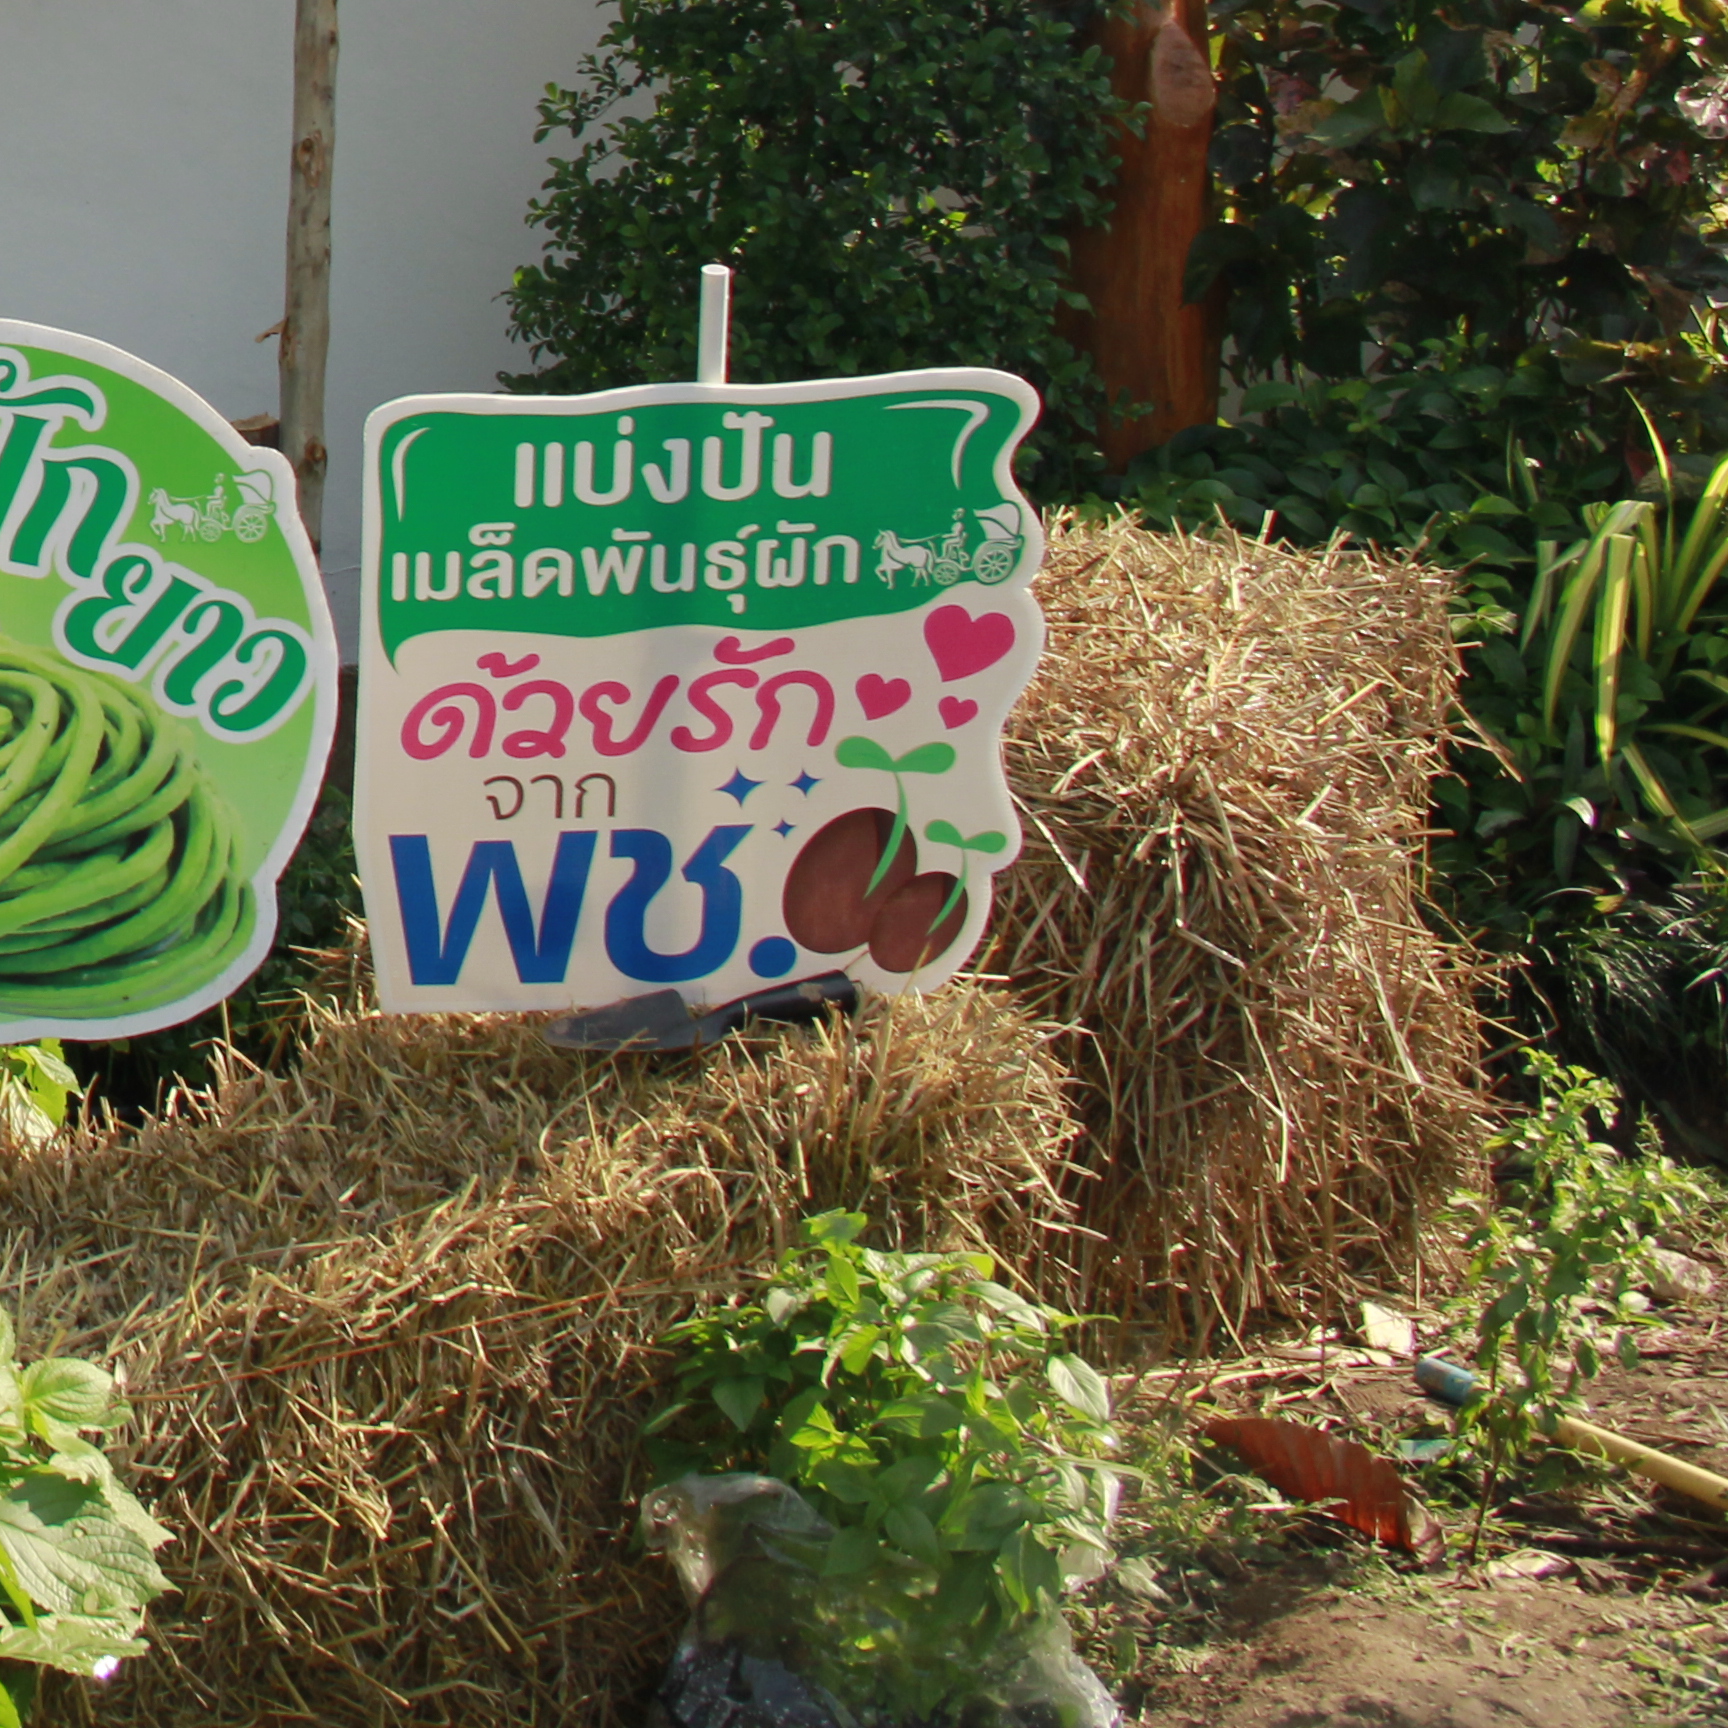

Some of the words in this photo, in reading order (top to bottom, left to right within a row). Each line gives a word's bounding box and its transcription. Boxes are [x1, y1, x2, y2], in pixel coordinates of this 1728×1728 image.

[514, 411, 833, 509] แบ่งปัน
[391, 521, 860, 614] เมล็ดพันธุ์ผัก
[62, 552, 308, 733] ยาว
[400, 636, 836, 760] ด้วยรัก
[484, 773, 617, 821] จาก
